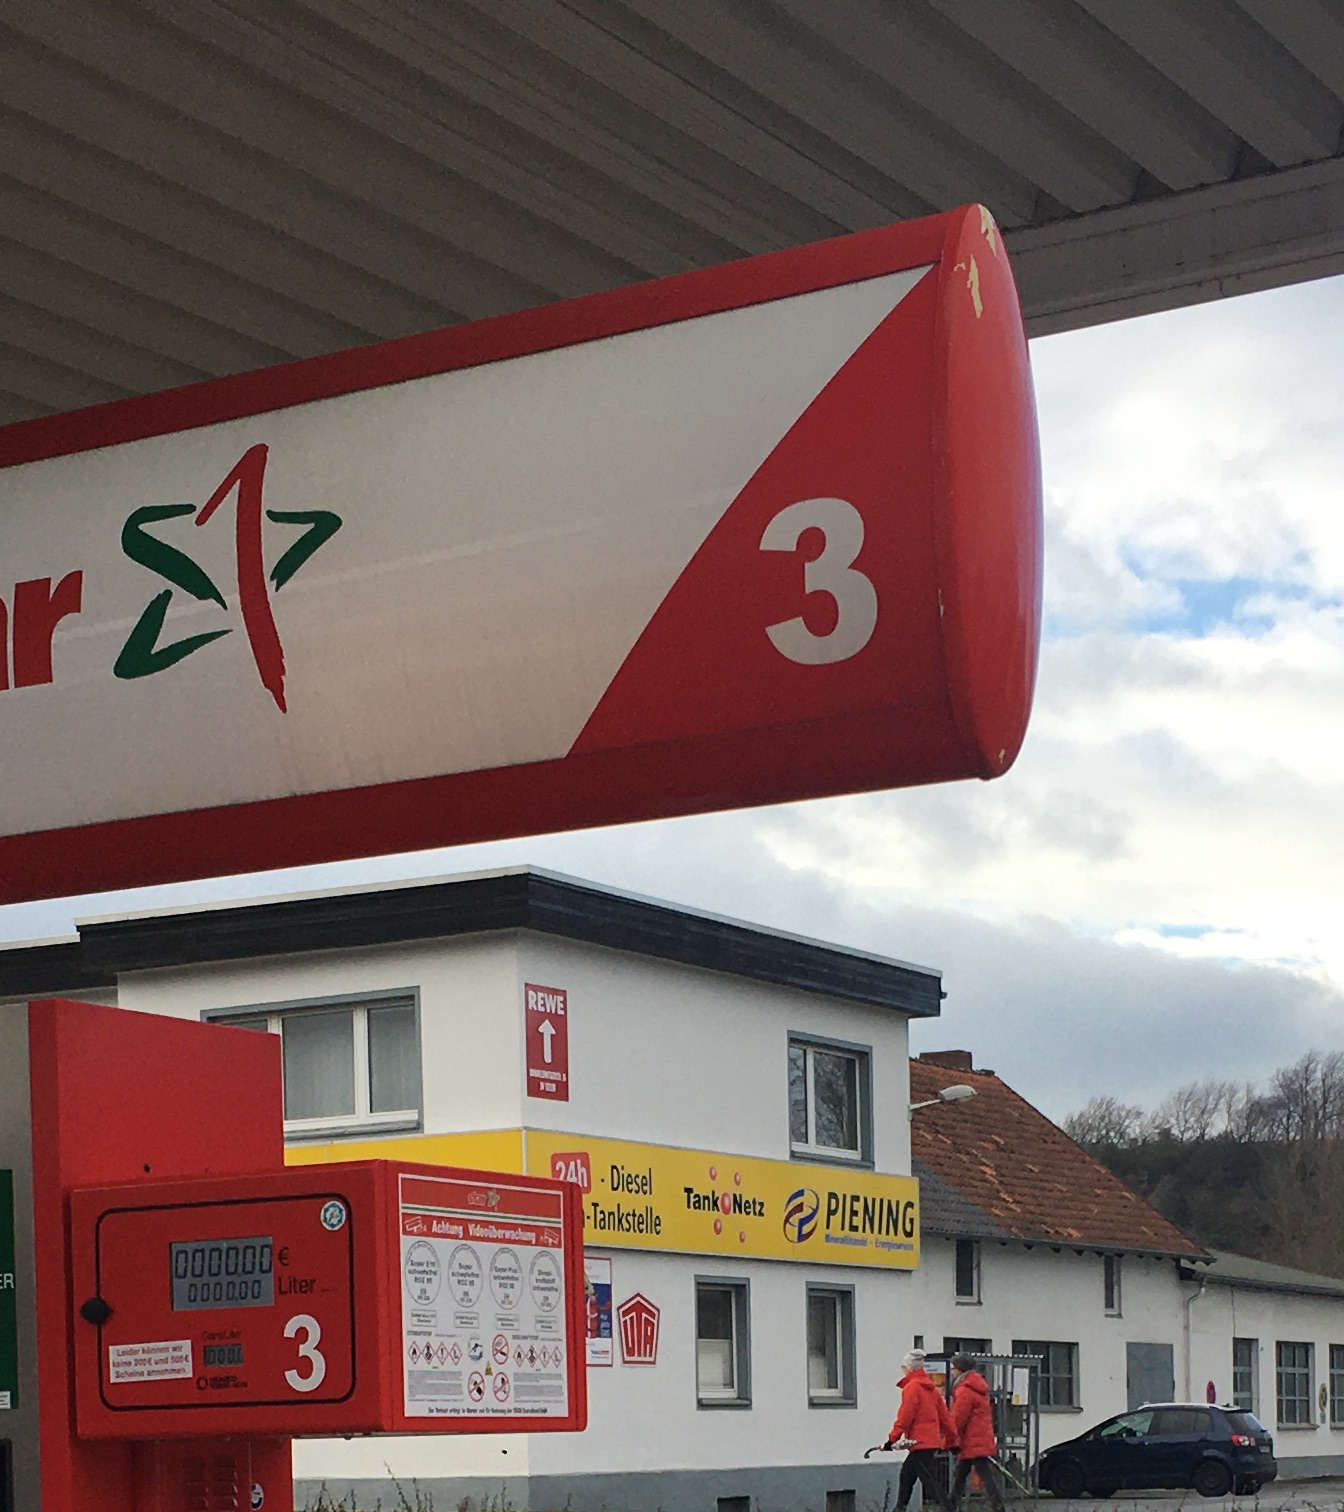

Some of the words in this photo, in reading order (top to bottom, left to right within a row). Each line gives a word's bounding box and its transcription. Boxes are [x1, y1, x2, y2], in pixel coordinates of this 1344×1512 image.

[758, 497, 879, 666] 3
[528, 990, 565, 1015] REWE
[555, 1159, 588, 1188] 24h
[610, 1165, 653, 1195] Diesel
[432, 1219, 463, 1238] Achtung
[468, 1222, 536, 1244] Videoüberwachung
[825, 1191, 915, 1239] PIENING
[278, 1246, 290, 1266] €
[278, 1276, 316, 1296] Liter
[621, 1300, 656, 1358] UTA
[283, 1314, 326, 1393] 3
